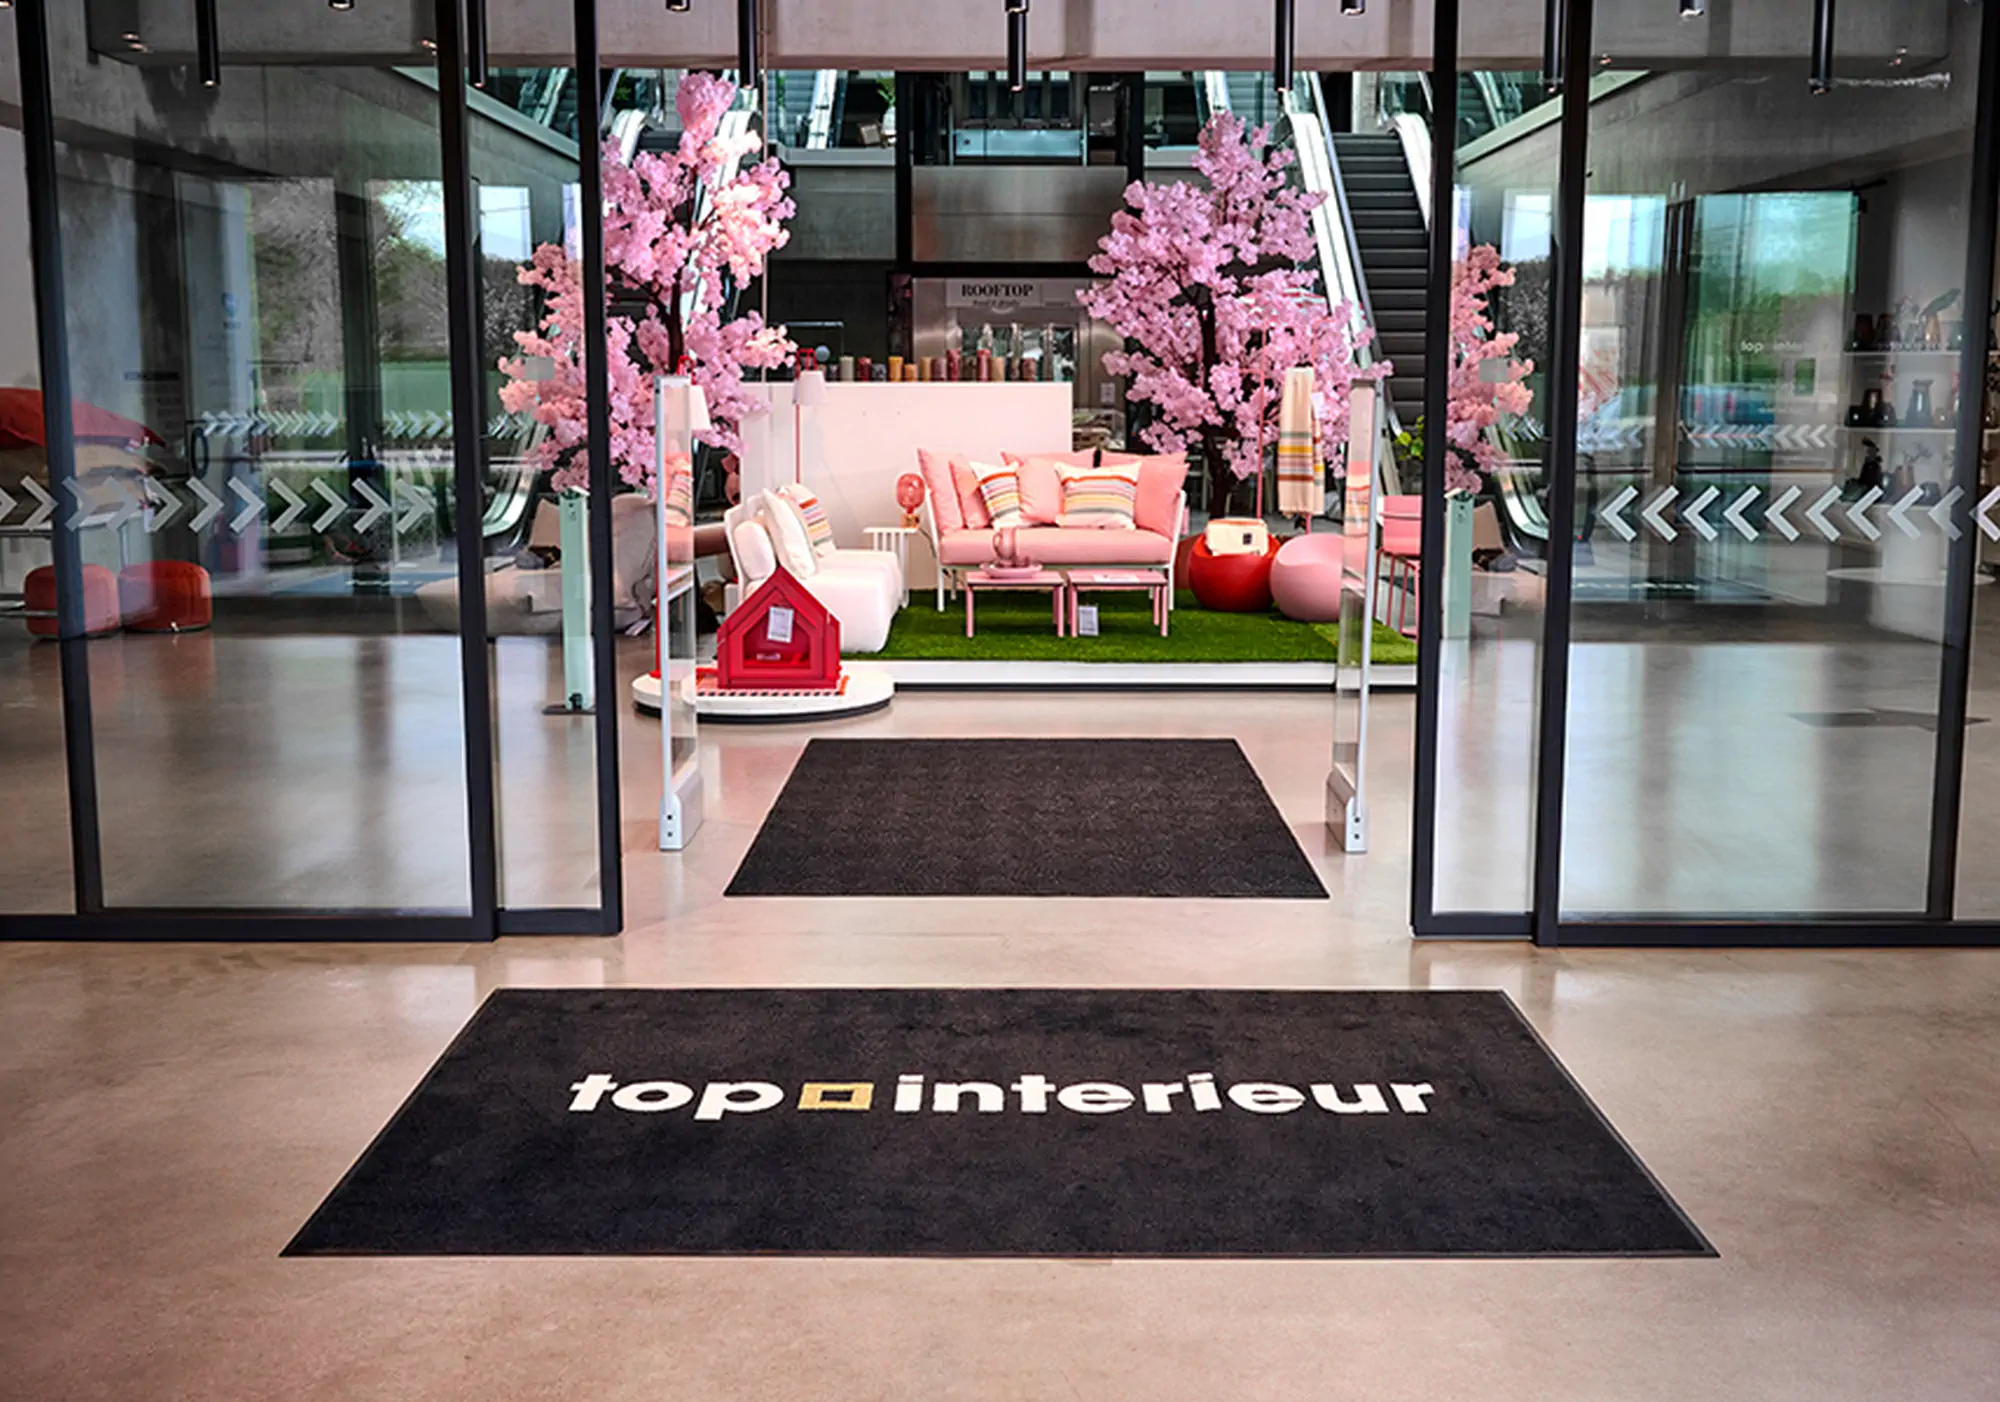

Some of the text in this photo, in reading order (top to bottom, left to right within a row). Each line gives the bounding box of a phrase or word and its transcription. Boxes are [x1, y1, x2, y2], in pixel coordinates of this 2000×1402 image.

[961, 283, 1034, 297] ROOFTOP
[1740, 340, 1764, 354] top
[568, 1072, 1436, 1121] top interieur
